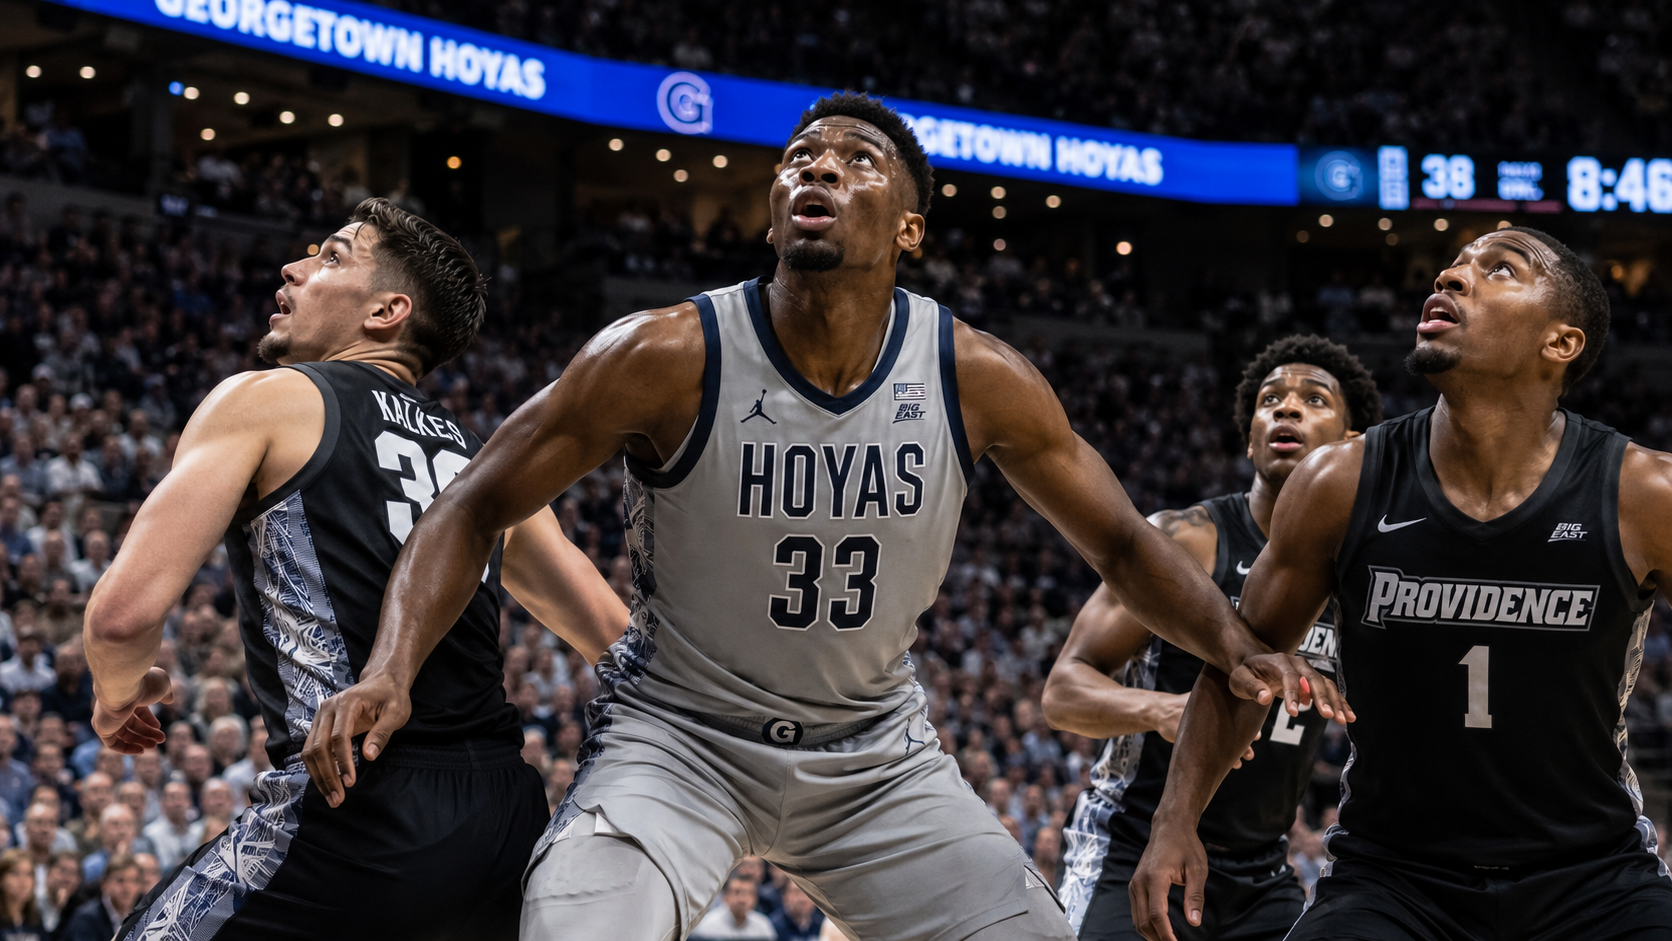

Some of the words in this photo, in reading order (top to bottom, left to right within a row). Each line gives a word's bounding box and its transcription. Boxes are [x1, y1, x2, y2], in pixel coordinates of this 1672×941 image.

[429, 35, 546, 100] HOYAS
[1056, 136, 1164, 186] HOYAS
[1421, 154, 1475, 199] 38
[1567, 156, 1672, 213] 8:46
[894, 411, 926, 420] EAST
[898, 403, 921, 412] BIG
[737, 441, 926, 520] HOYAS
[1550, 530, 1588, 539] EAST
[1555, 522, 1582, 531] BIG
[767, 533, 882, 631] 33
[1365, 570, 1596, 628] PROVIDENCE
[1458, 645, 1492, 728] 1
[770, 720, 796, 743] G
